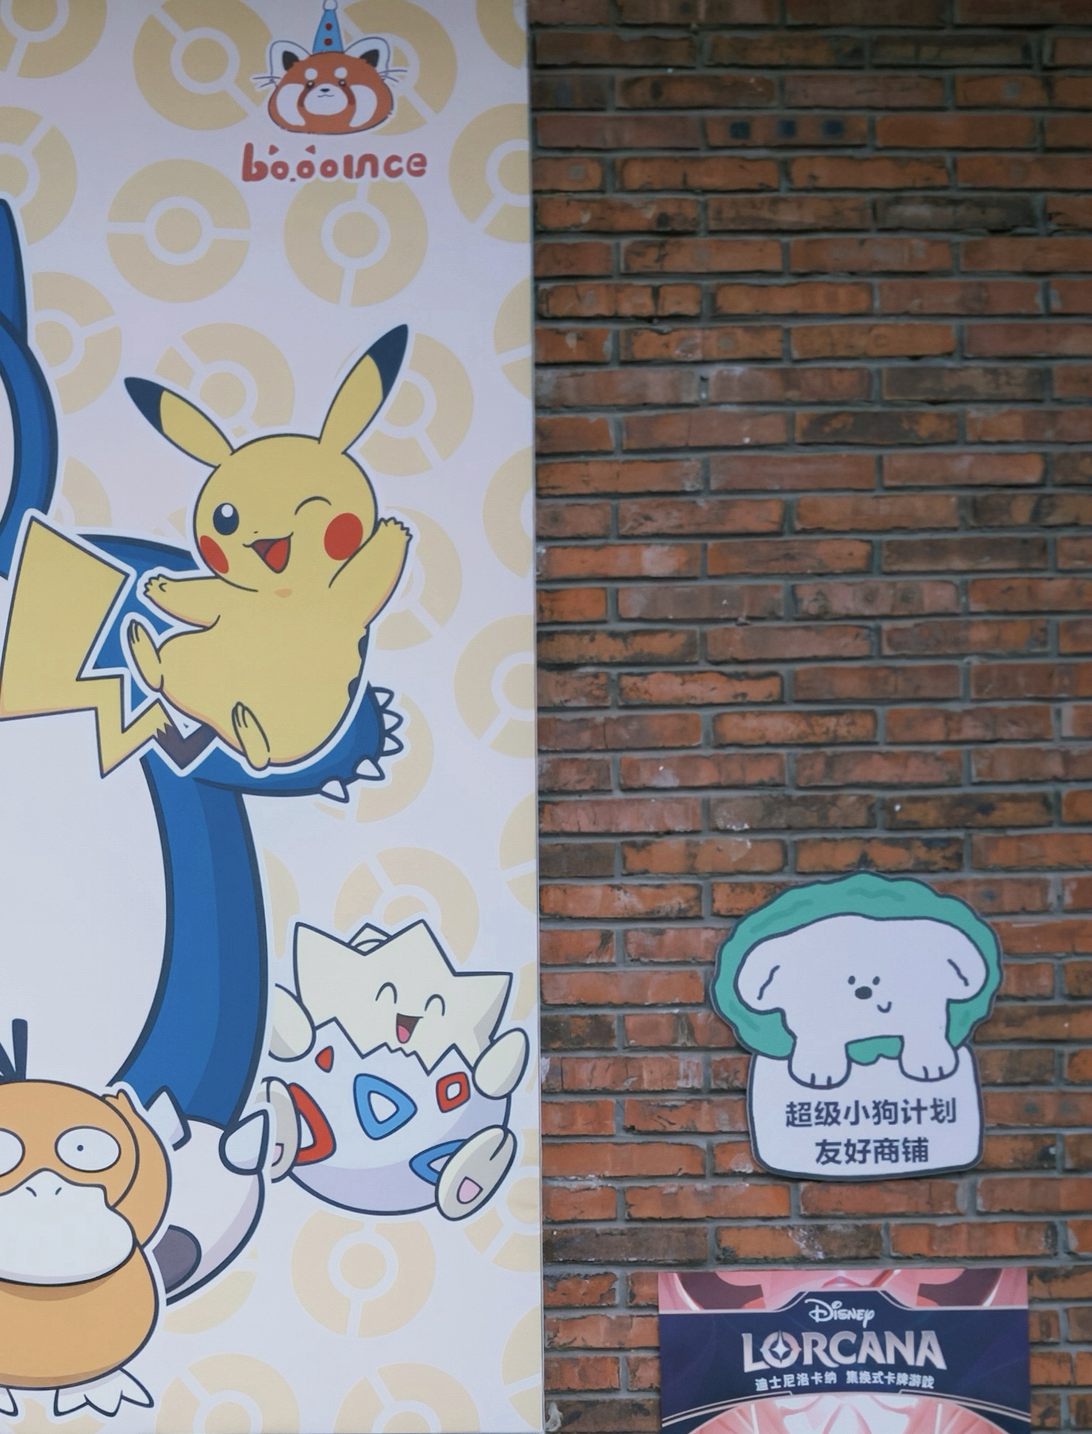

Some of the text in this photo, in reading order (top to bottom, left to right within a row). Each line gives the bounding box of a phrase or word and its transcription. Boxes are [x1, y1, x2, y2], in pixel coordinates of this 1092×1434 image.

[785, 1097, 957, 1128] 超级小狗计划
[815, 1136, 929, 1165] 友好商铺
[741, 1330, 948, 1373] LORCANA
[755, 1370, 935, 1391] 迪士尼洛卡纳 集换式卡牌游戏
